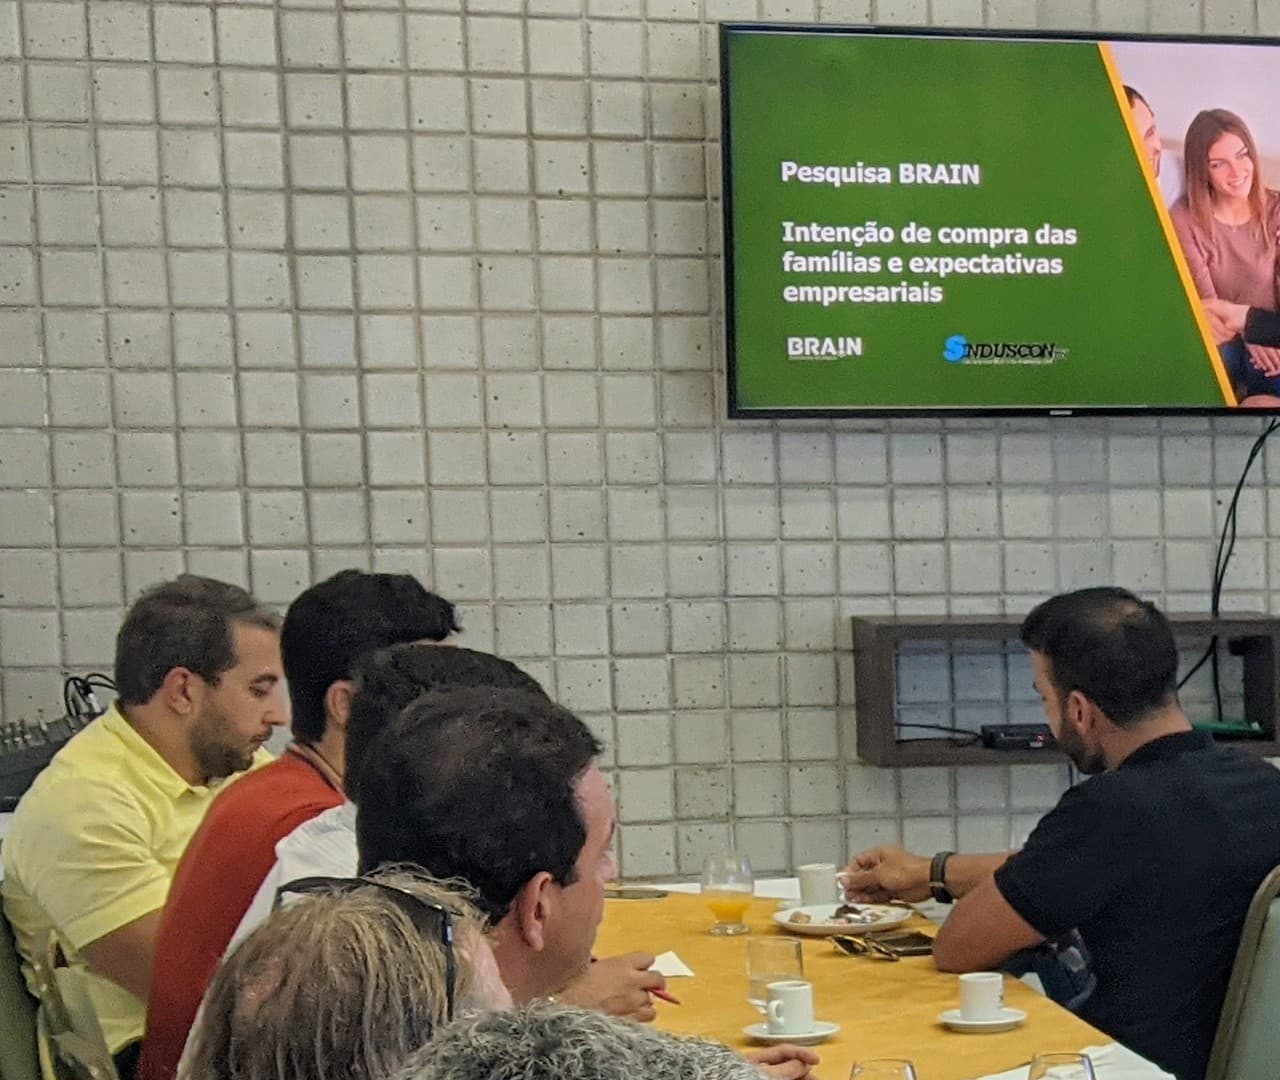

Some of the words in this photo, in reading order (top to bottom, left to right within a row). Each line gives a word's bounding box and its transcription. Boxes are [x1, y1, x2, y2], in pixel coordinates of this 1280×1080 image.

[781, 161, 892, 188] Pesquisa
[899, 163, 981, 185] BRAIN
[782, 221, 895, 248] Intenção
[901, 222, 932, 244] de
[938, 228, 1029, 249] compra
[1035, 223, 1078, 245] das
[781, 249, 882, 273] famílias
[888, 256, 904, 273] e
[909, 252, 1064, 278] expectativas
[783, 281, 944, 307] empresariais
[943, 334, 1055, 362] SINDUSCON
